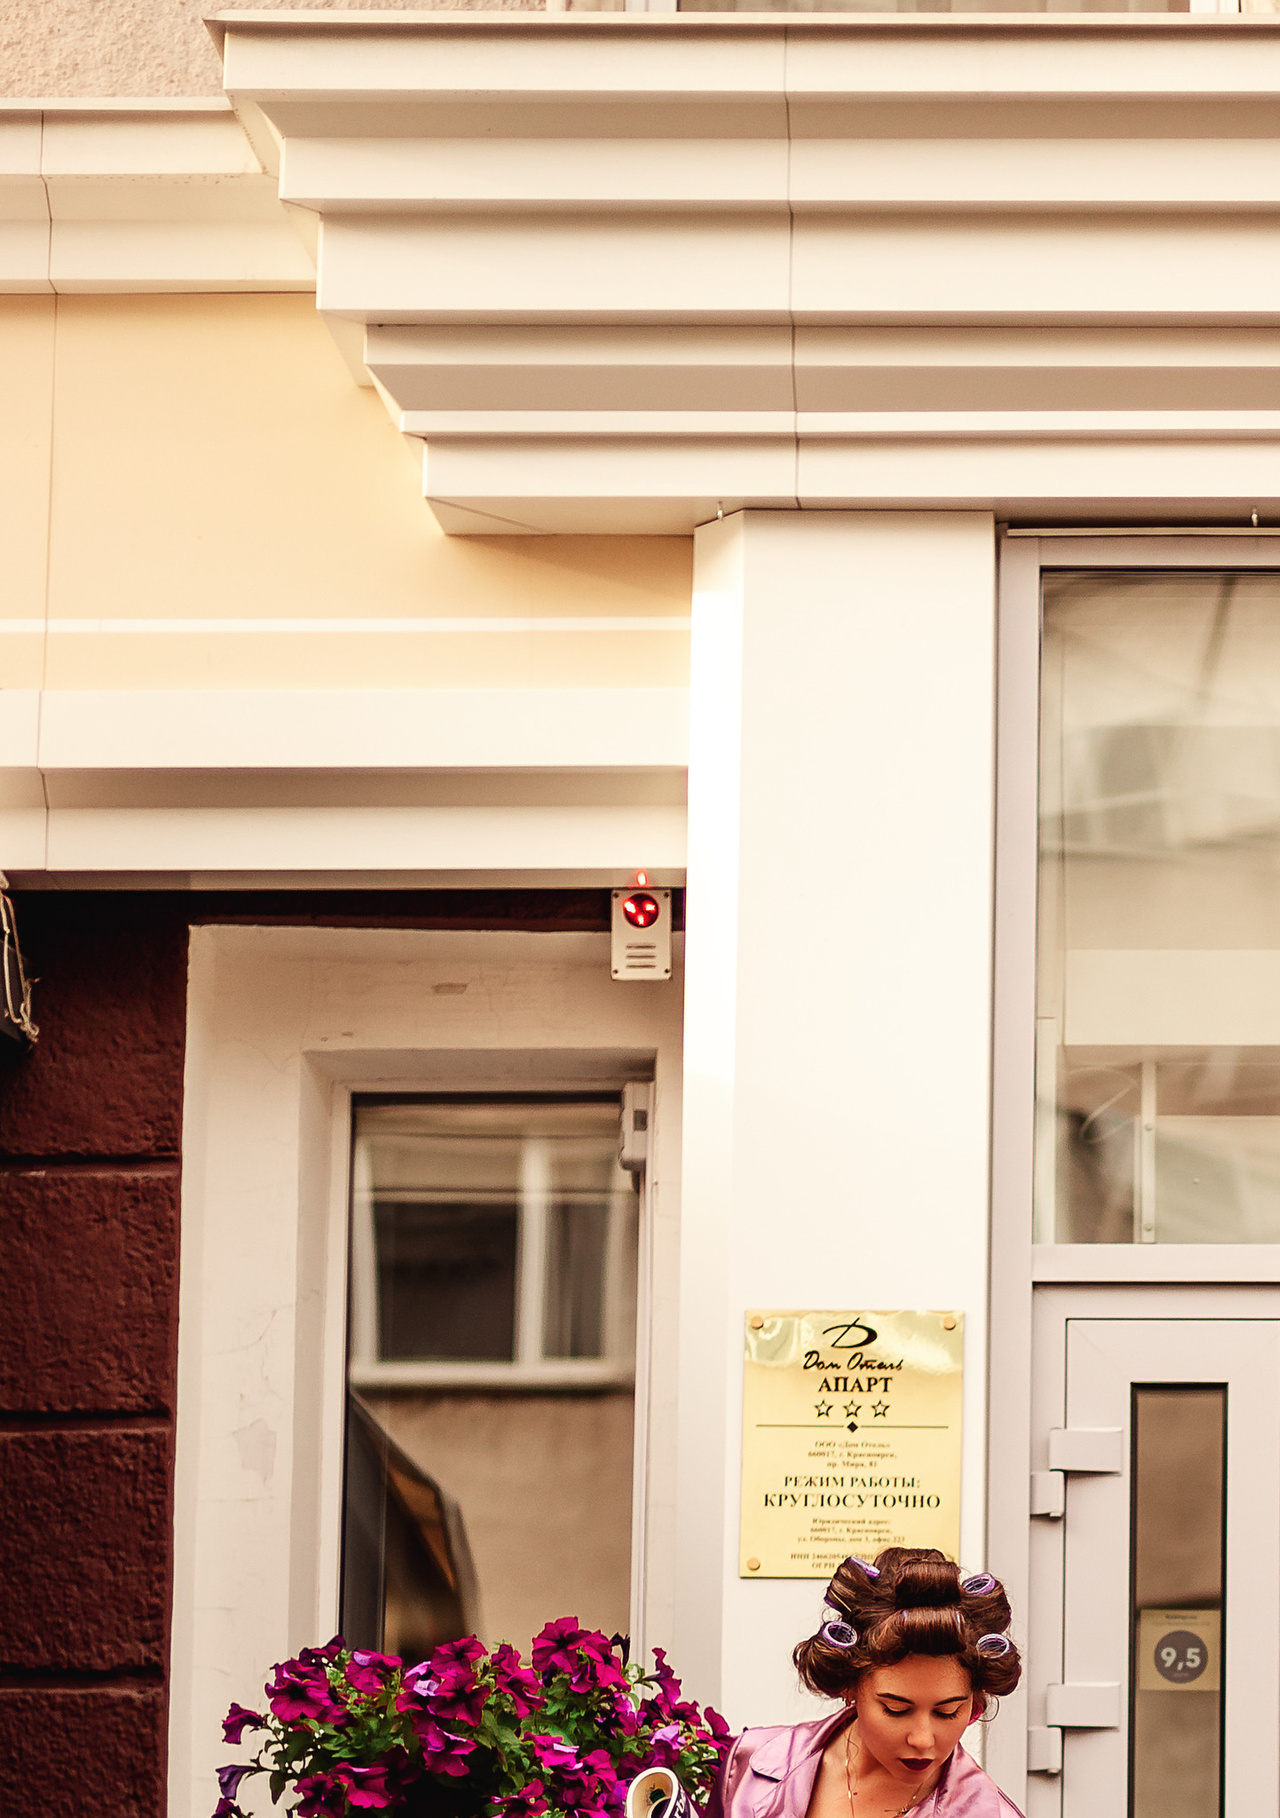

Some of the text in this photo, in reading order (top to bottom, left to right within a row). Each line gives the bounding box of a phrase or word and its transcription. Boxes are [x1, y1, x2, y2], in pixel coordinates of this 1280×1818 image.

[803, 1350, 904, 1371] Дом Отель
[818, 1377, 893, 1393] АПАРТ
[784, 1476, 921, 1488] РЕЖИМ РАБОТЫ:
[764, 1493, 941, 1509] КРУГЛОСУТОЧНО
[1160, 1647, 1201, 1671] 9,5
